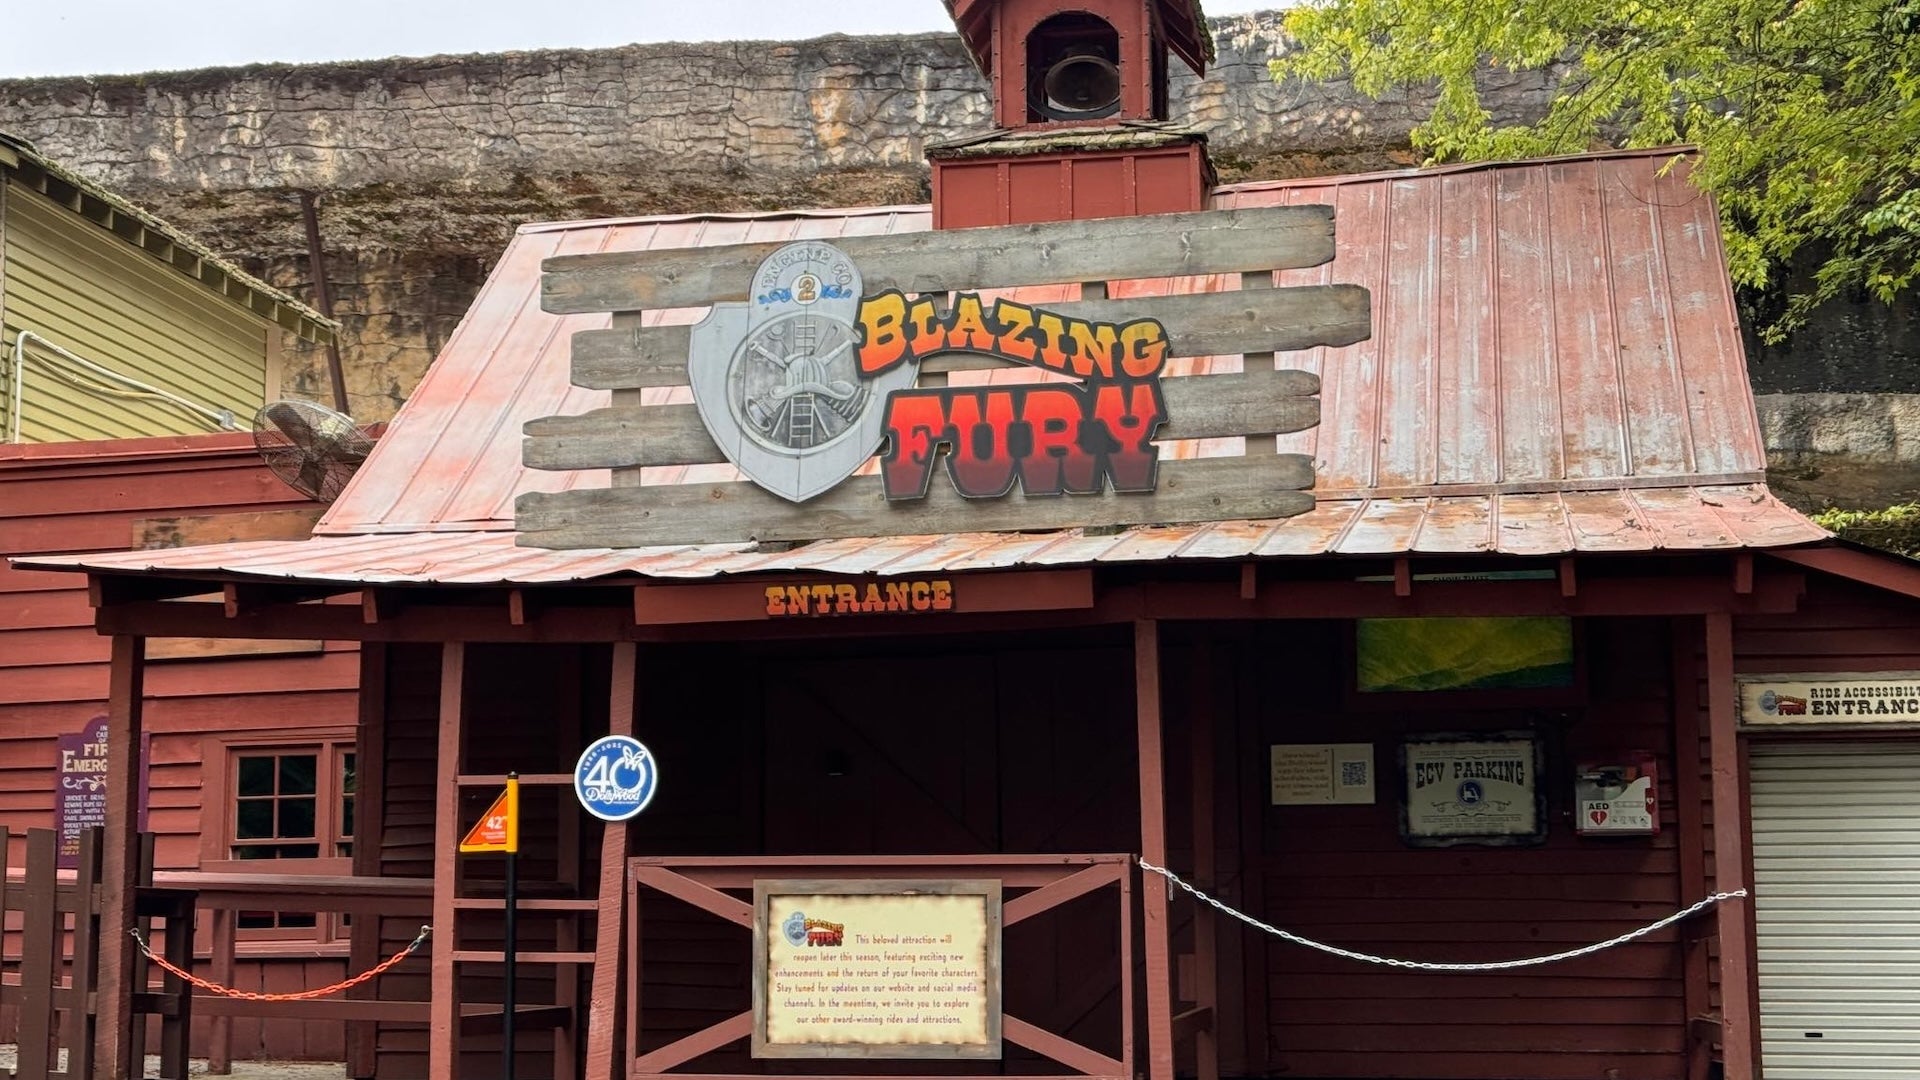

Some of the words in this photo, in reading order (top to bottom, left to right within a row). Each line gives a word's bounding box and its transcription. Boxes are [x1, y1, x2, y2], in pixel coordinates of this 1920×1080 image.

[761, 247, 832, 289] ENGINE
[798, 276, 816, 301] 2
[858, 291, 1168, 378] BLAZING
[885, 384, 1159, 498] FURY
[766, 581, 952, 615] ENTRANCE
[1810, 688, 1840, 698] RIDE
[1811, 699, 1919, 715] ENTRANC
[583, 755, 646, 793] 40
[1415, 762, 1445, 789] ECV
[1453, 760, 1525, 786] PARKING
[1588, 802, 1609, 810] AED
[856, 934, 869, 944] This
[873, 934, 898, 944] beloved
[902, 934, 936, 944] attraction
[940, 934, 952, 944] will
[793, 954, 817, 964] reopen
[820, 952, 837, 961] later
[840, 952, 852, 961] this
[856, 954, 881, 963] season,
[884, 951, 916, 963] featuring
[920, 952, 946, 964] exciting
[775, 967, 823, 977] enhancements
[827, 967, 839, 977] and
[842, 967, 853, 977] the
[857, 968, 878, 977] return
[882, 966, 890, 977] of
[893, 970, 908, 979] your
[911, 966, 938, 977] favorite
[777, 983, 792, 993] Stay
[795, 982, 815, 992] tuned
[818, 982, 828, 992] for
[831, 982, 858, 994] updates
[889, 982, 914, 992] website
[918, 982, 930, 992] and
[933, 982, 953, 992] social
[957, 982, 977, 992] media
[784, 998, 815, 1007] channels.
[819, 998, 825, 1007] In
[828, 998, 840, 1007] the
[843, 998, 878, 1009] meantime,
[894, 998, 914, 1007] invite
[917, 1001, 929, 1009] you
[933, 999, 940, 1007] to
[943, 998, 969, 1009] explore
[811, 1014, 830, 1023] other
[833, 1014, 883, 1025] award-winning
[886, 1014, 903, 1023] rides
[906, 1013, 919, 1023] and
[922, 1014, 962, 1024] attractions.
